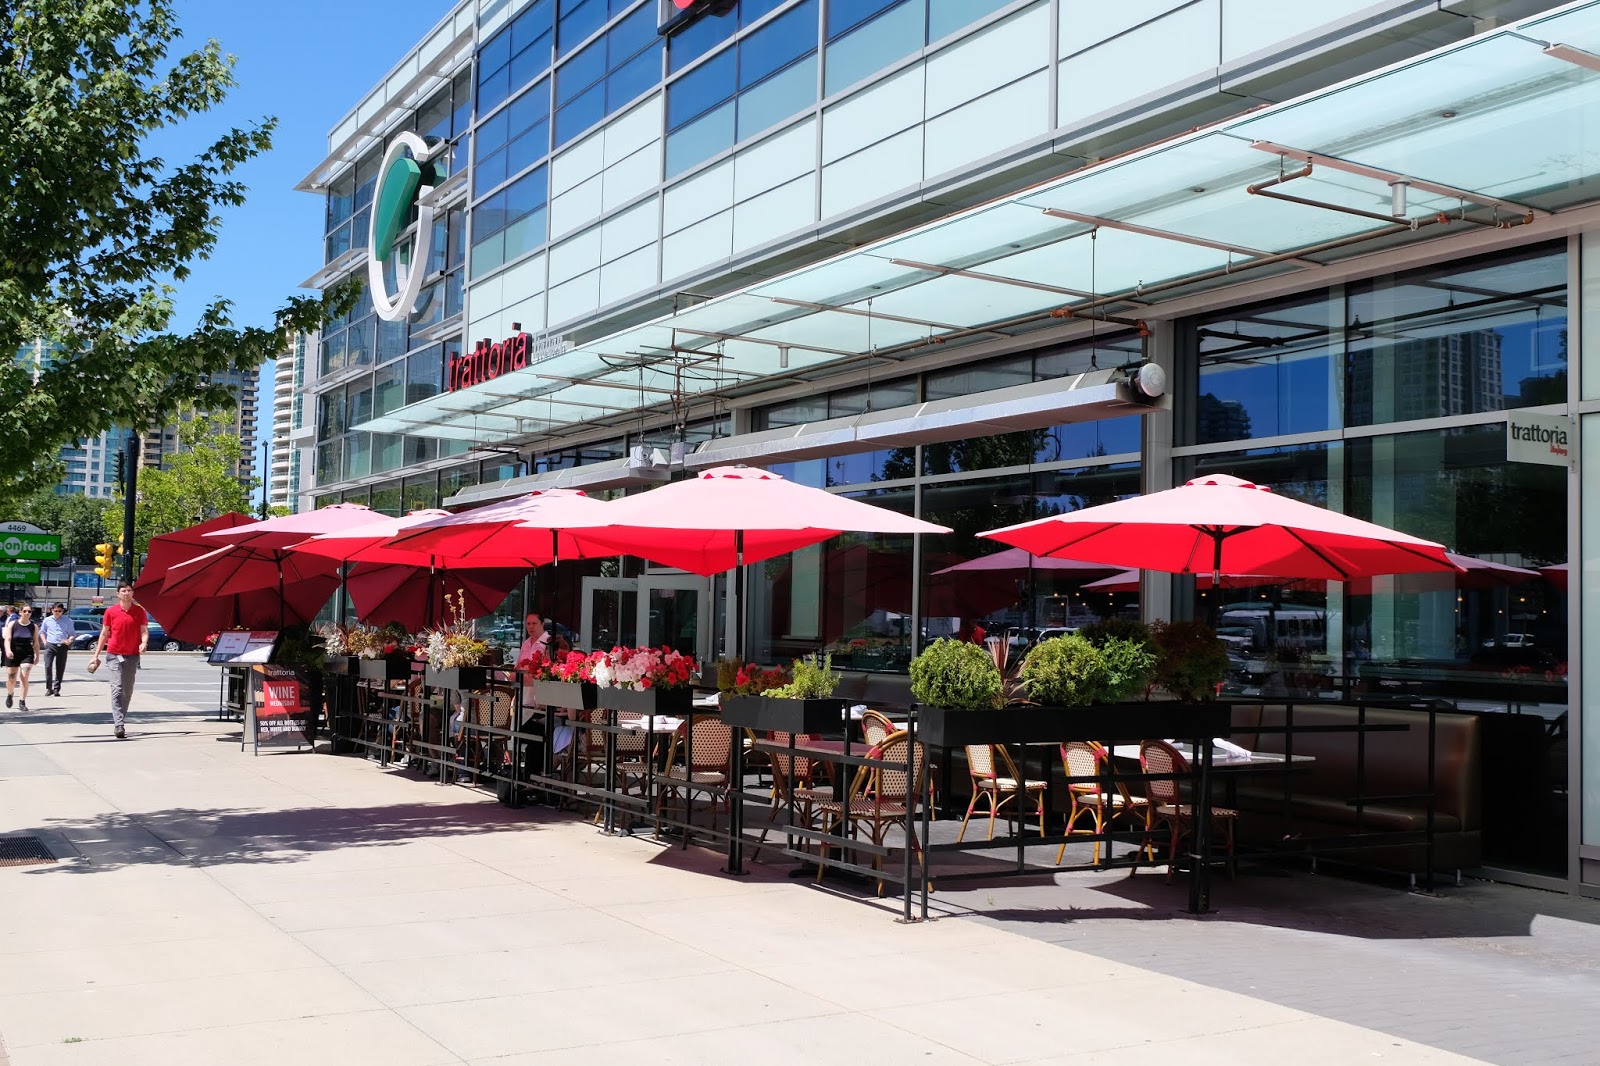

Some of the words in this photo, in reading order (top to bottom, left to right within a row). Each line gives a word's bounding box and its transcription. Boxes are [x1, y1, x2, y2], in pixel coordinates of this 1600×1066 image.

[447, 322, 531, 393] trattoria
[1511, 422, 1568, 445] trattoria
[8, 524, 26, 532] 4469
[12, 566, 39, 574] shopping
[269, 686, 295, 699] WINE
